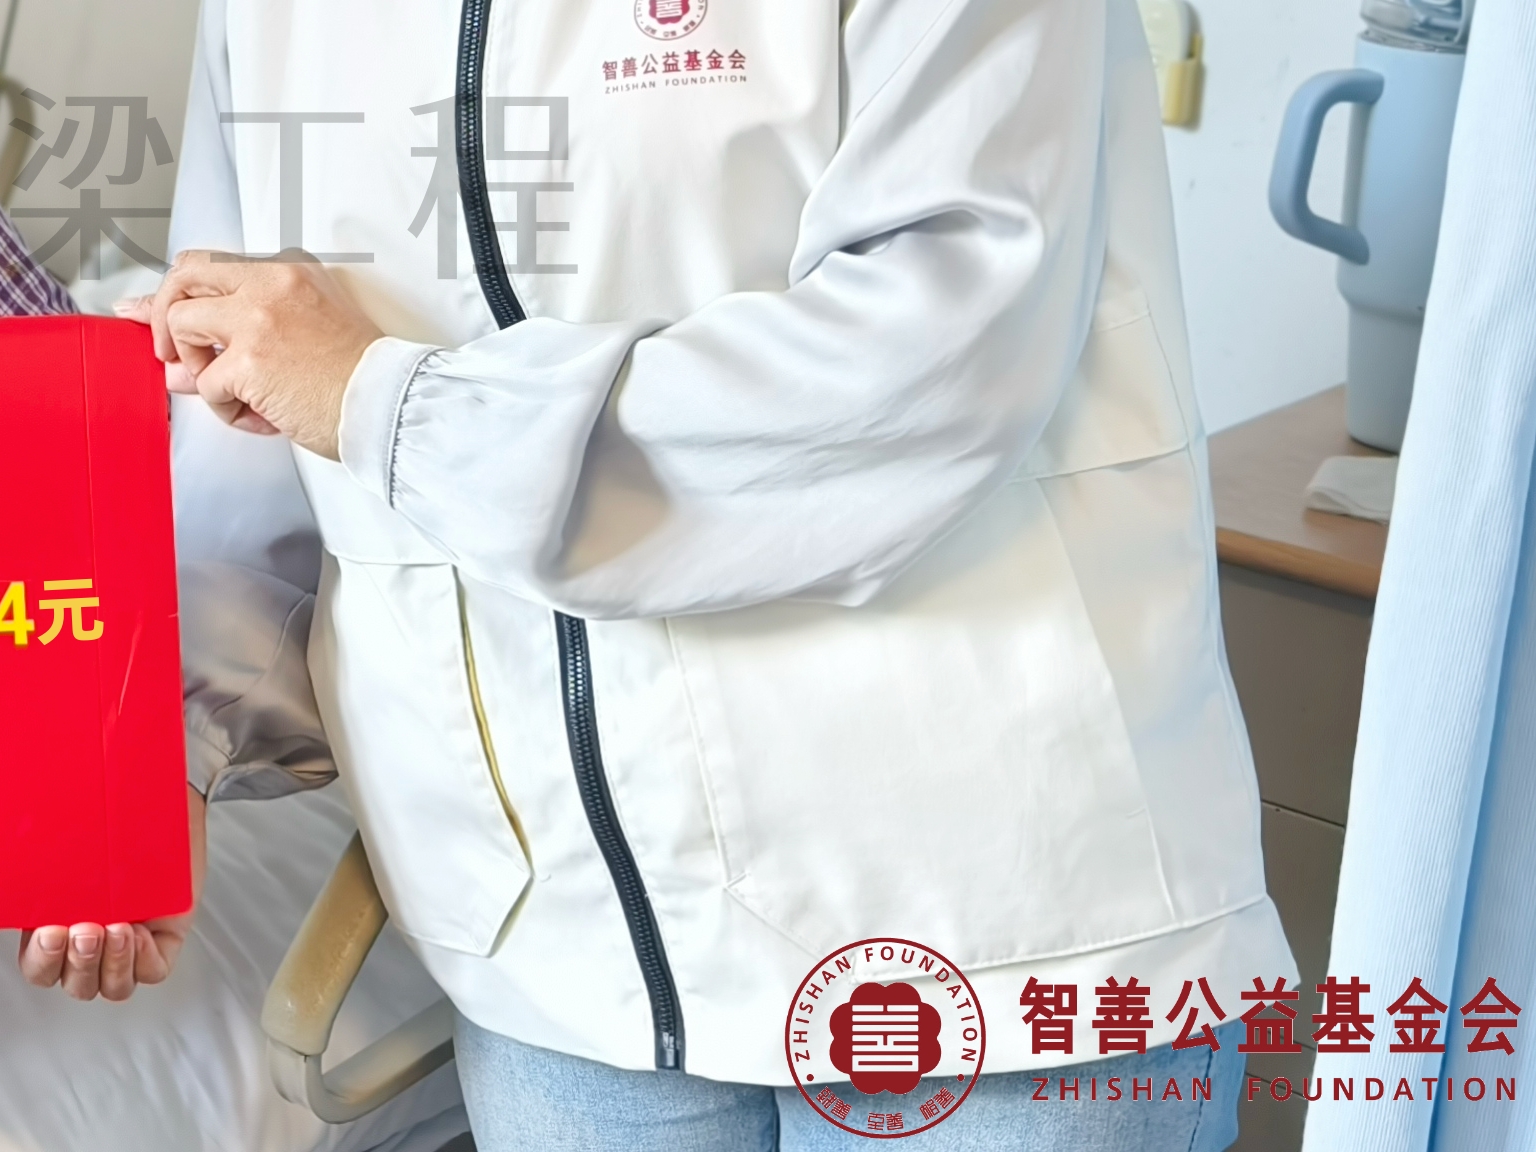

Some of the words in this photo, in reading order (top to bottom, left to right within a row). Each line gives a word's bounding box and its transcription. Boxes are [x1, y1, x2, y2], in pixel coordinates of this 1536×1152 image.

[602, 49, 747, 81] 智善公益基金会
[605, 81, 656, 95] ZHISHAN
[665, 75, 747, 87] FOUNDATION
